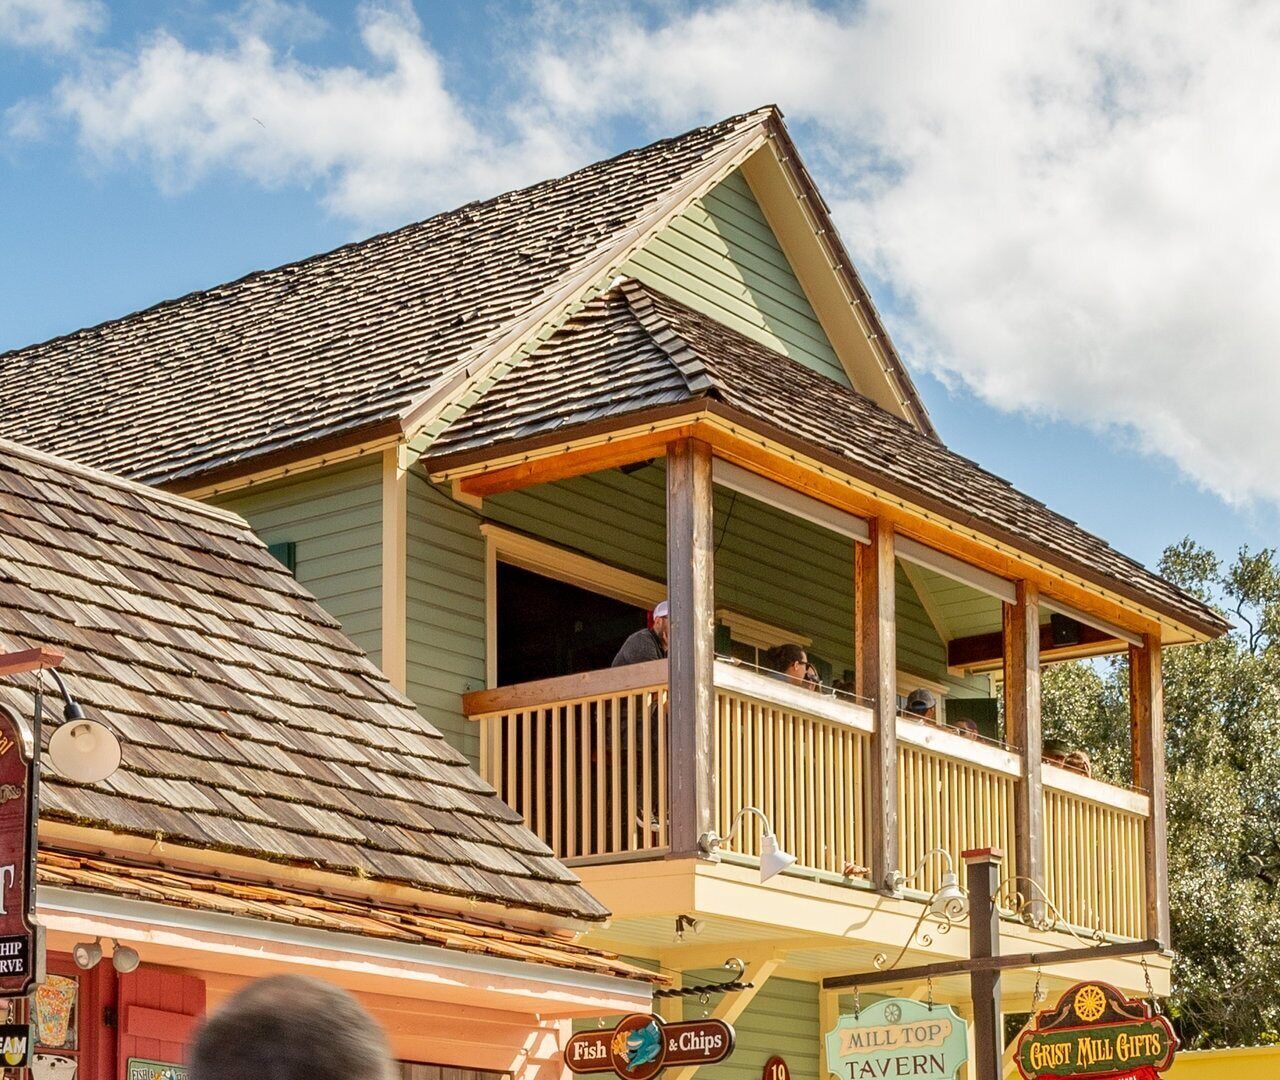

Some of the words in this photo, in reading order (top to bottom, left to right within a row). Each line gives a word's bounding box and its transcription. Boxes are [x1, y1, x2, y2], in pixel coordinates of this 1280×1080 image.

[573, 1040, 607, 1061] Fish
[669, 1039, 678, 1051] &
[679, 1031, 722, 1055] Chips
[848, 1030, 897, 1049] MILL
[901, 1024, 941, 1043] TOP
[1030, 1042, 1071, 1069] GRIST
[1077, 1036, 1113, 1069] MILL
[1116, 1033, 1161, 1062] GIFTS
[845, 1053, 945, 1080] TAVERN
